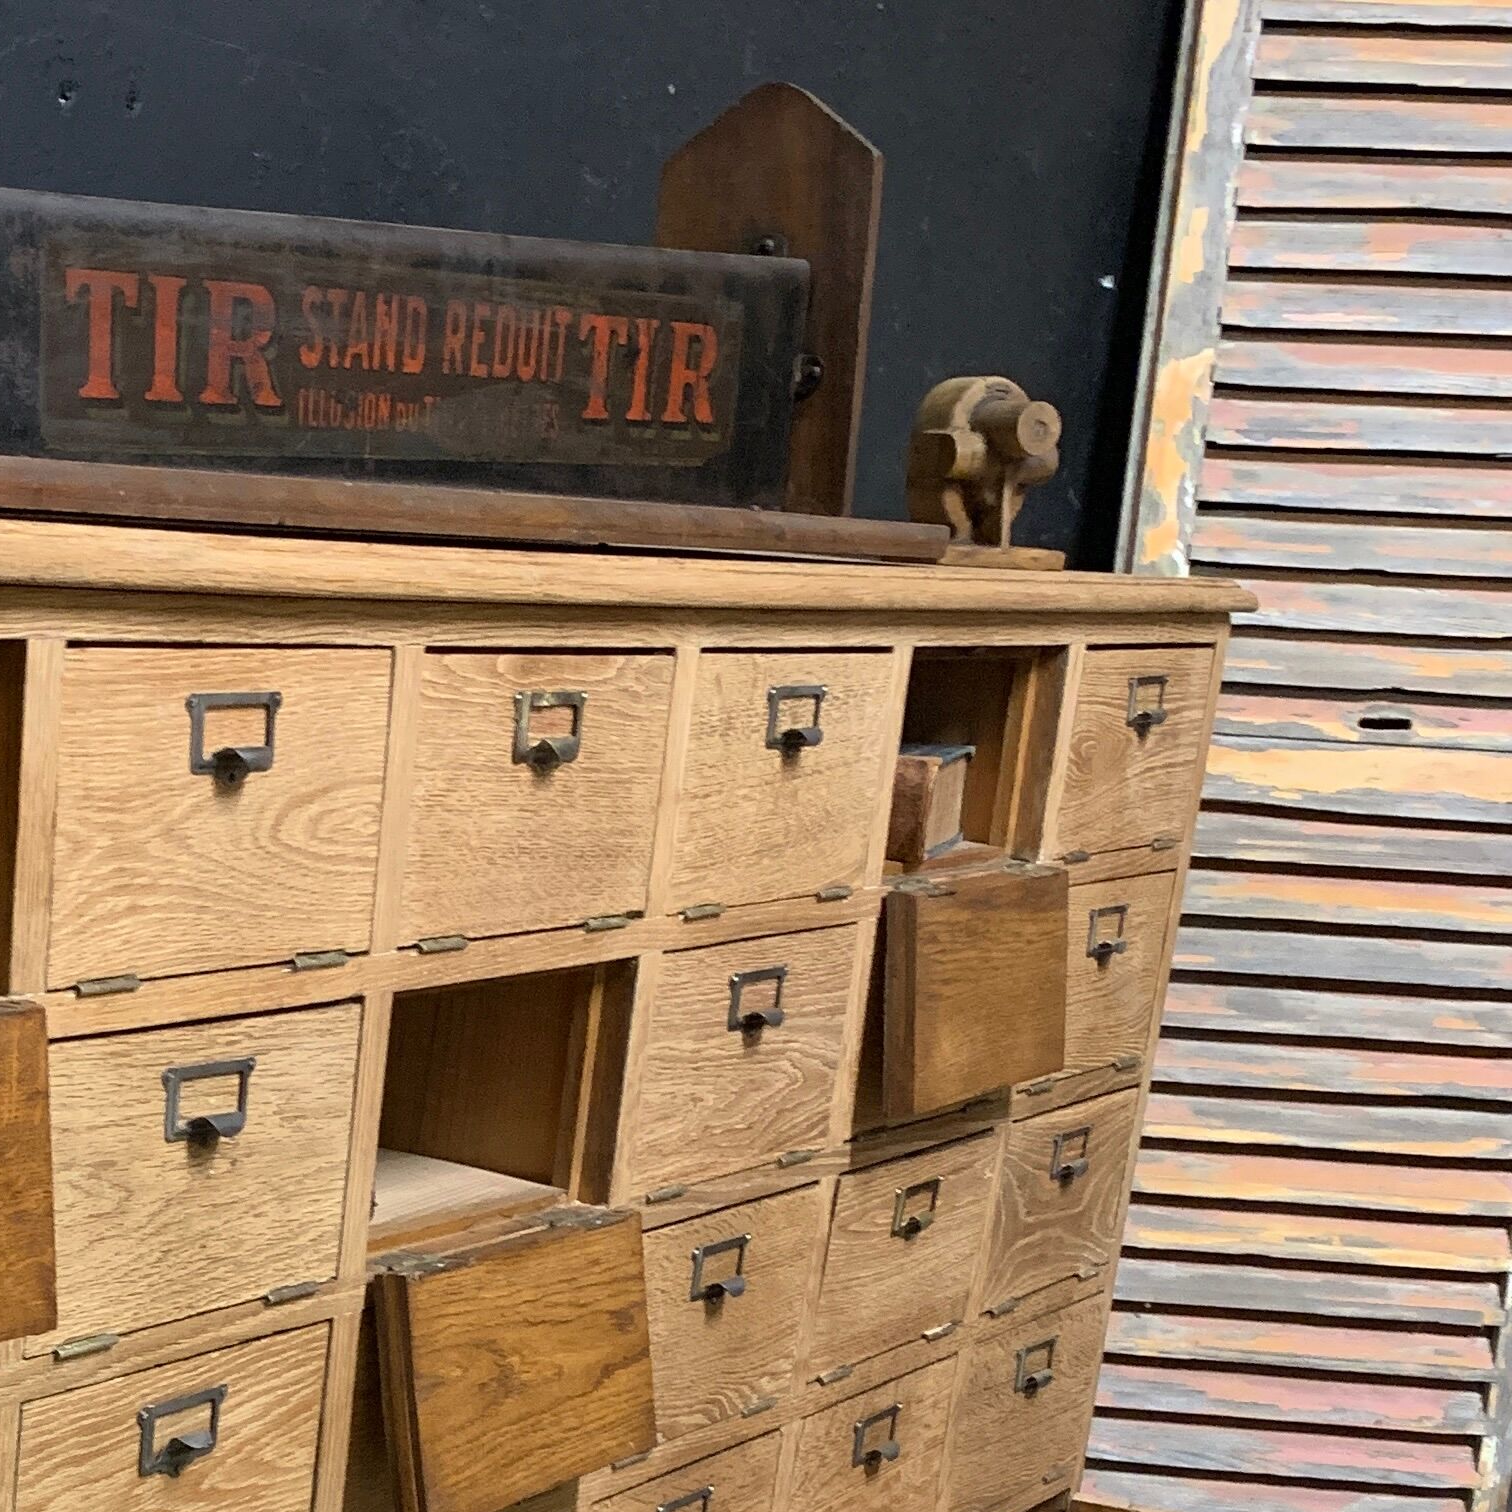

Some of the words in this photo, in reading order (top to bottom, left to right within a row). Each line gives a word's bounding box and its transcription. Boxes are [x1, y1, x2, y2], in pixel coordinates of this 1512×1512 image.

[65, 268, 283, 406] TIR
[299, 285, 428, 374] STAND
[442, 302, 572, 383] REDUIT
[578, 313, 718, 424] TIR
